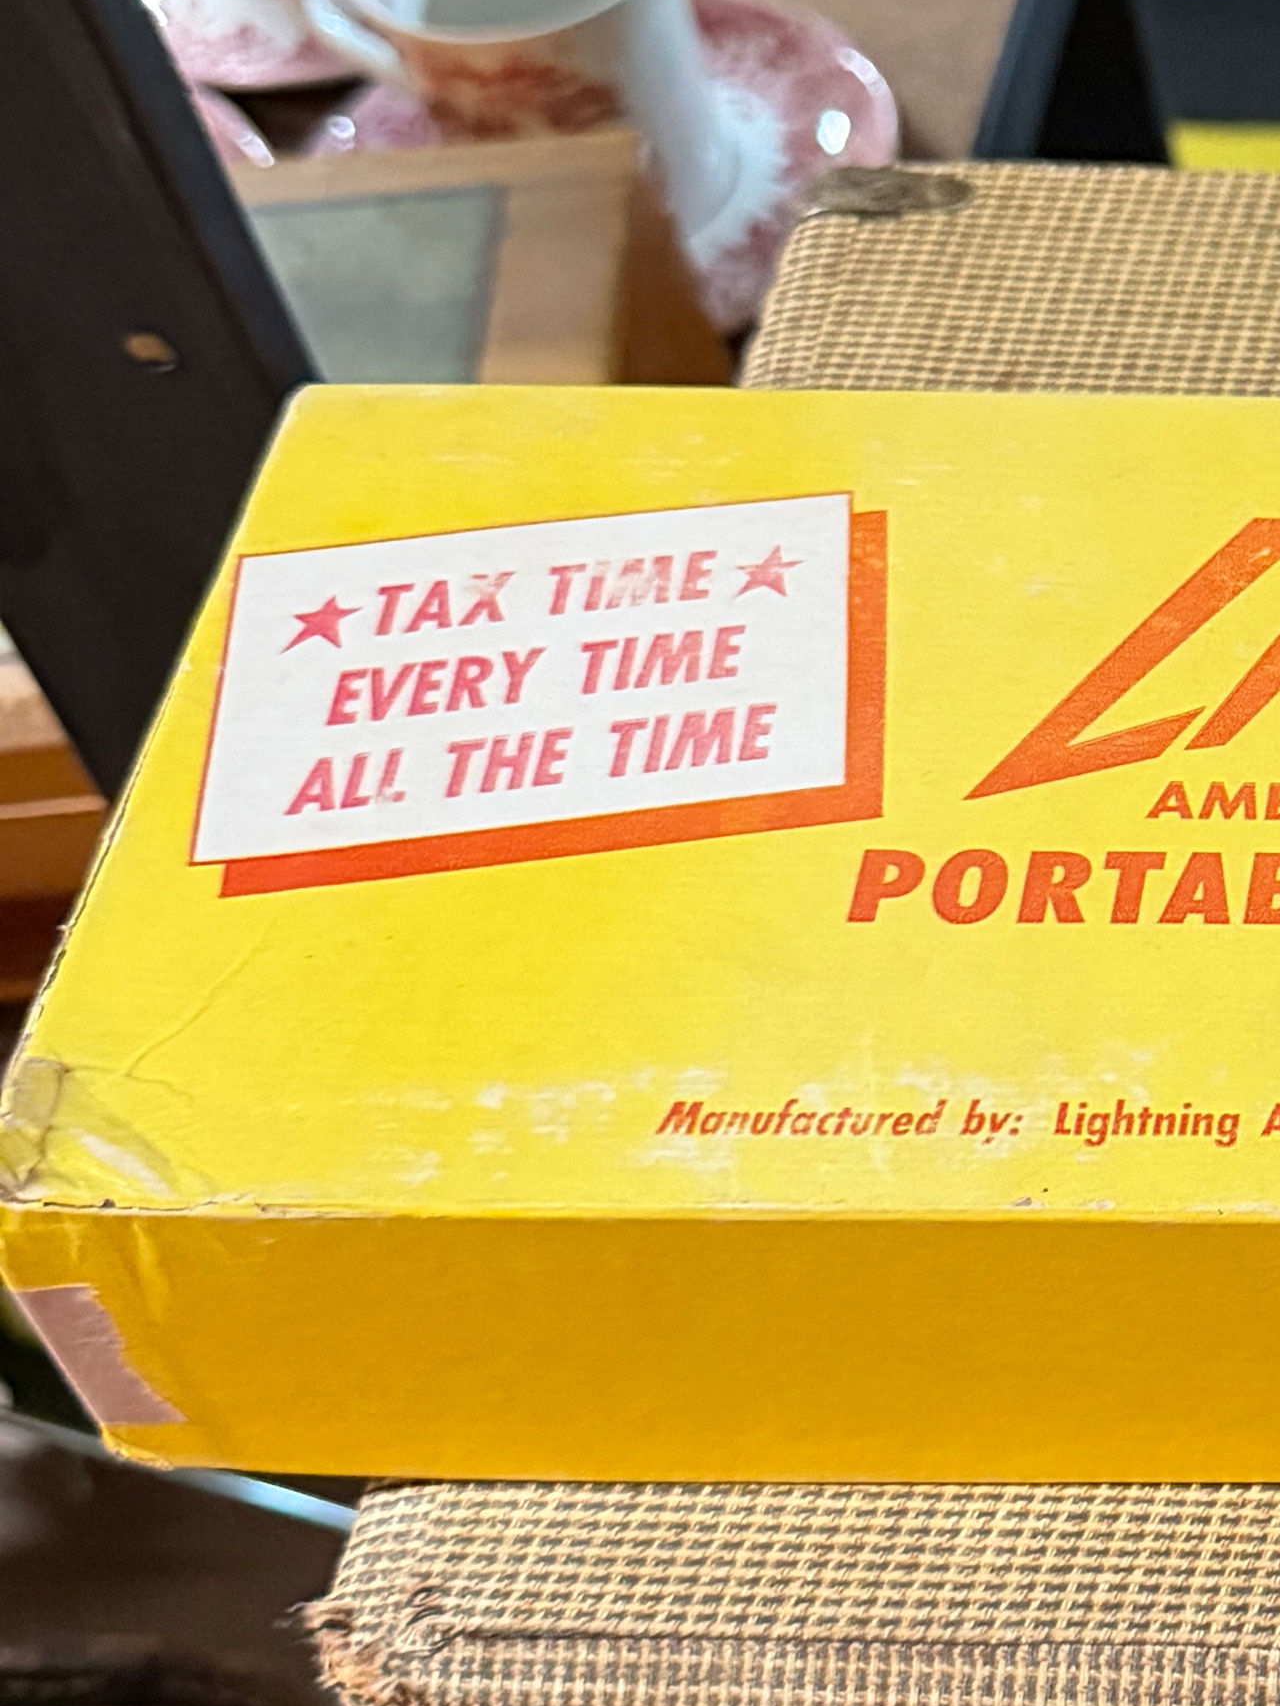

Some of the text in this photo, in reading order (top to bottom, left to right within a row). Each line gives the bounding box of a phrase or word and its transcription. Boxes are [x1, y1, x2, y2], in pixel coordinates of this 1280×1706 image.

[374, 550, 718, 636] TAX TIME
[326, 624, 746, 727] EVERY TIME
[284, 702, 777, 817] ALL THE TIME
[655, 1099, 943, 1138] Manufactured
[1055, 1102, 1240, 1148] Lightning
